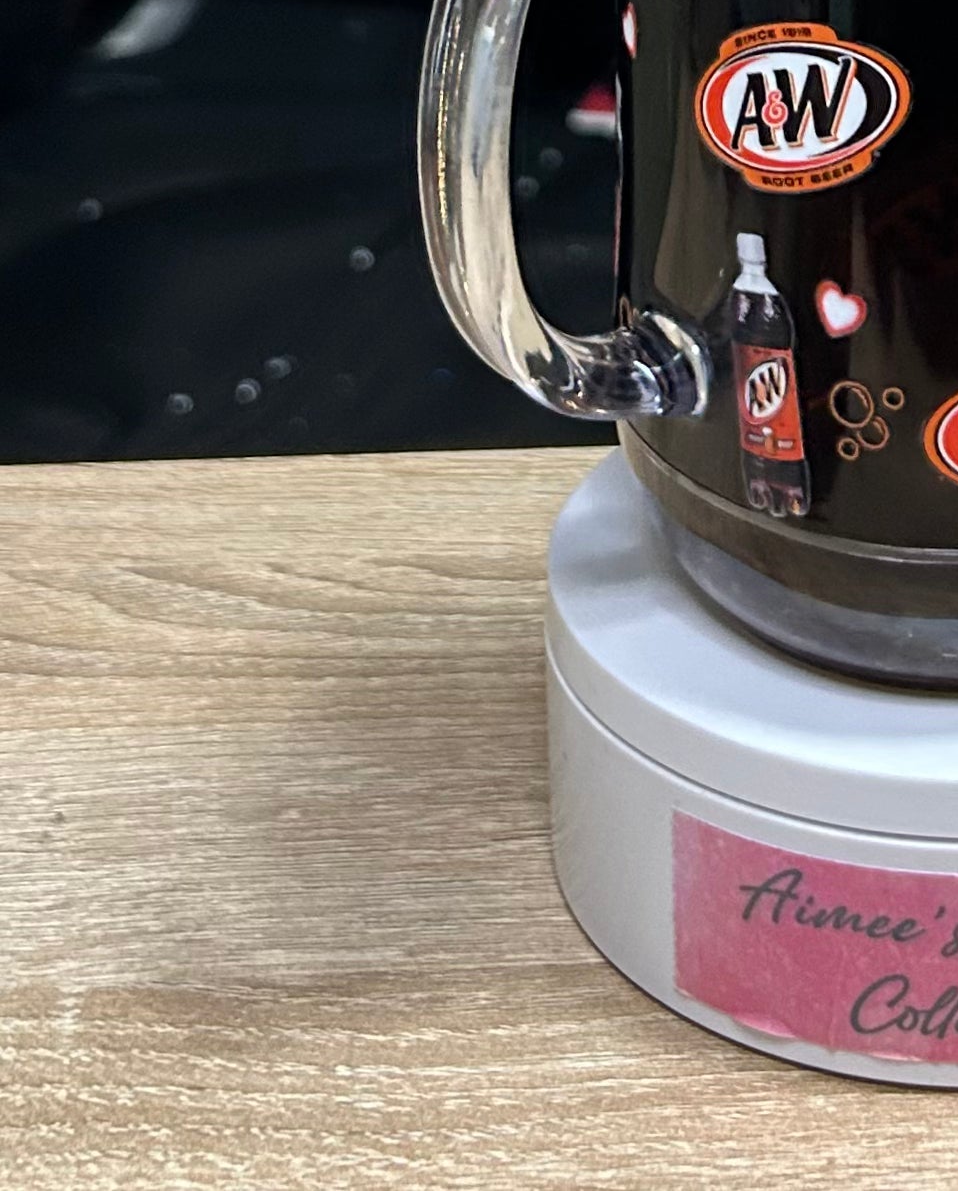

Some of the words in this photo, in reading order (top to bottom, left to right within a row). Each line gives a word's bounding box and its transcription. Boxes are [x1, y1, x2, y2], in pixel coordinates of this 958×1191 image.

[734, 29, 777, 47] SINCE
[731, 56, 858, 151] A&W
[762, 176, 804, 187] ROOT
[811, 163, 854, 184] BEER
